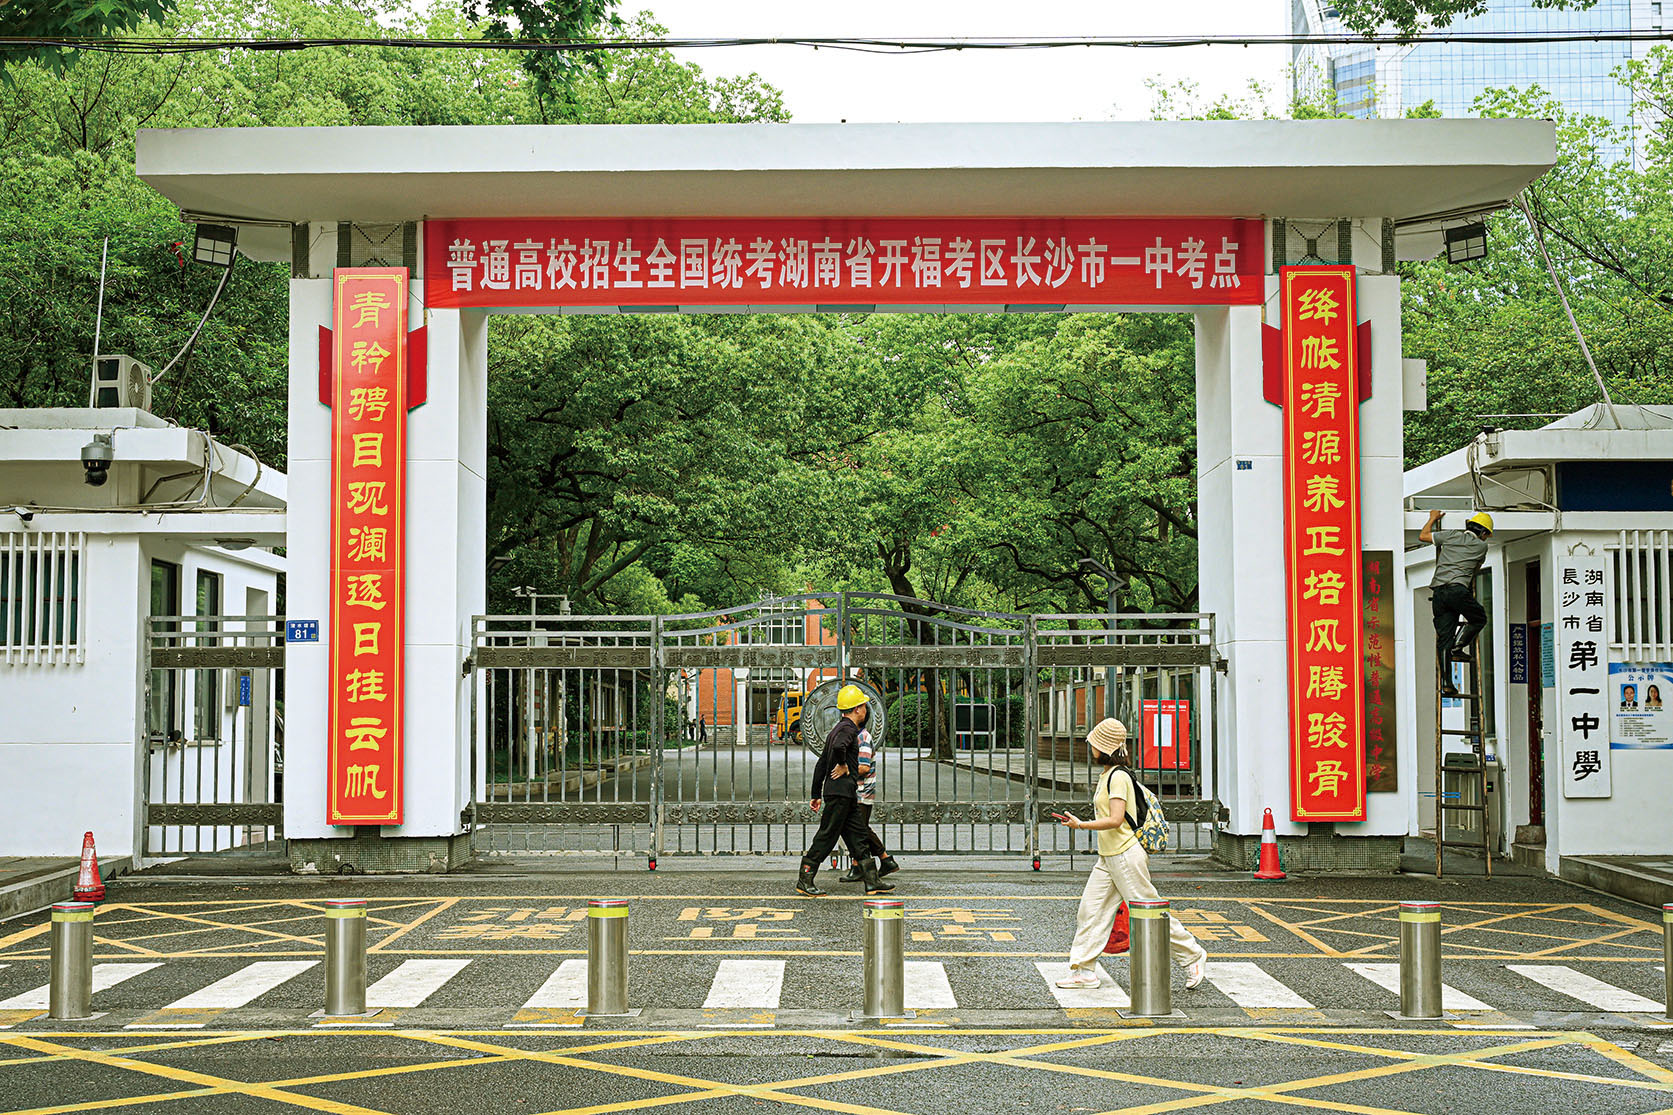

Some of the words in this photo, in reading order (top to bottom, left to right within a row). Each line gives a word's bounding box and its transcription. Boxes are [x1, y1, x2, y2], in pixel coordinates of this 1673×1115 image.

[446, 236, 1241, 292] 普通高校招生全国统考湖南省开福考区长沙市一中考点
[344, 290, 392, 800] 青衿骋目观澜逐日挂云帆
[1297, 287, 1349, 799] 绛帐清源养正培风腾骏骨
[295, 629, 308, 639] 81
[1562, 568, 1581, 630] 長沙市
[1585, 569, 1604, 632] 湖南省
[1365, 560, 1386, 782] 湖南省示范性普通高级中学
[1568, 640, 1602, 781] 第一中學
